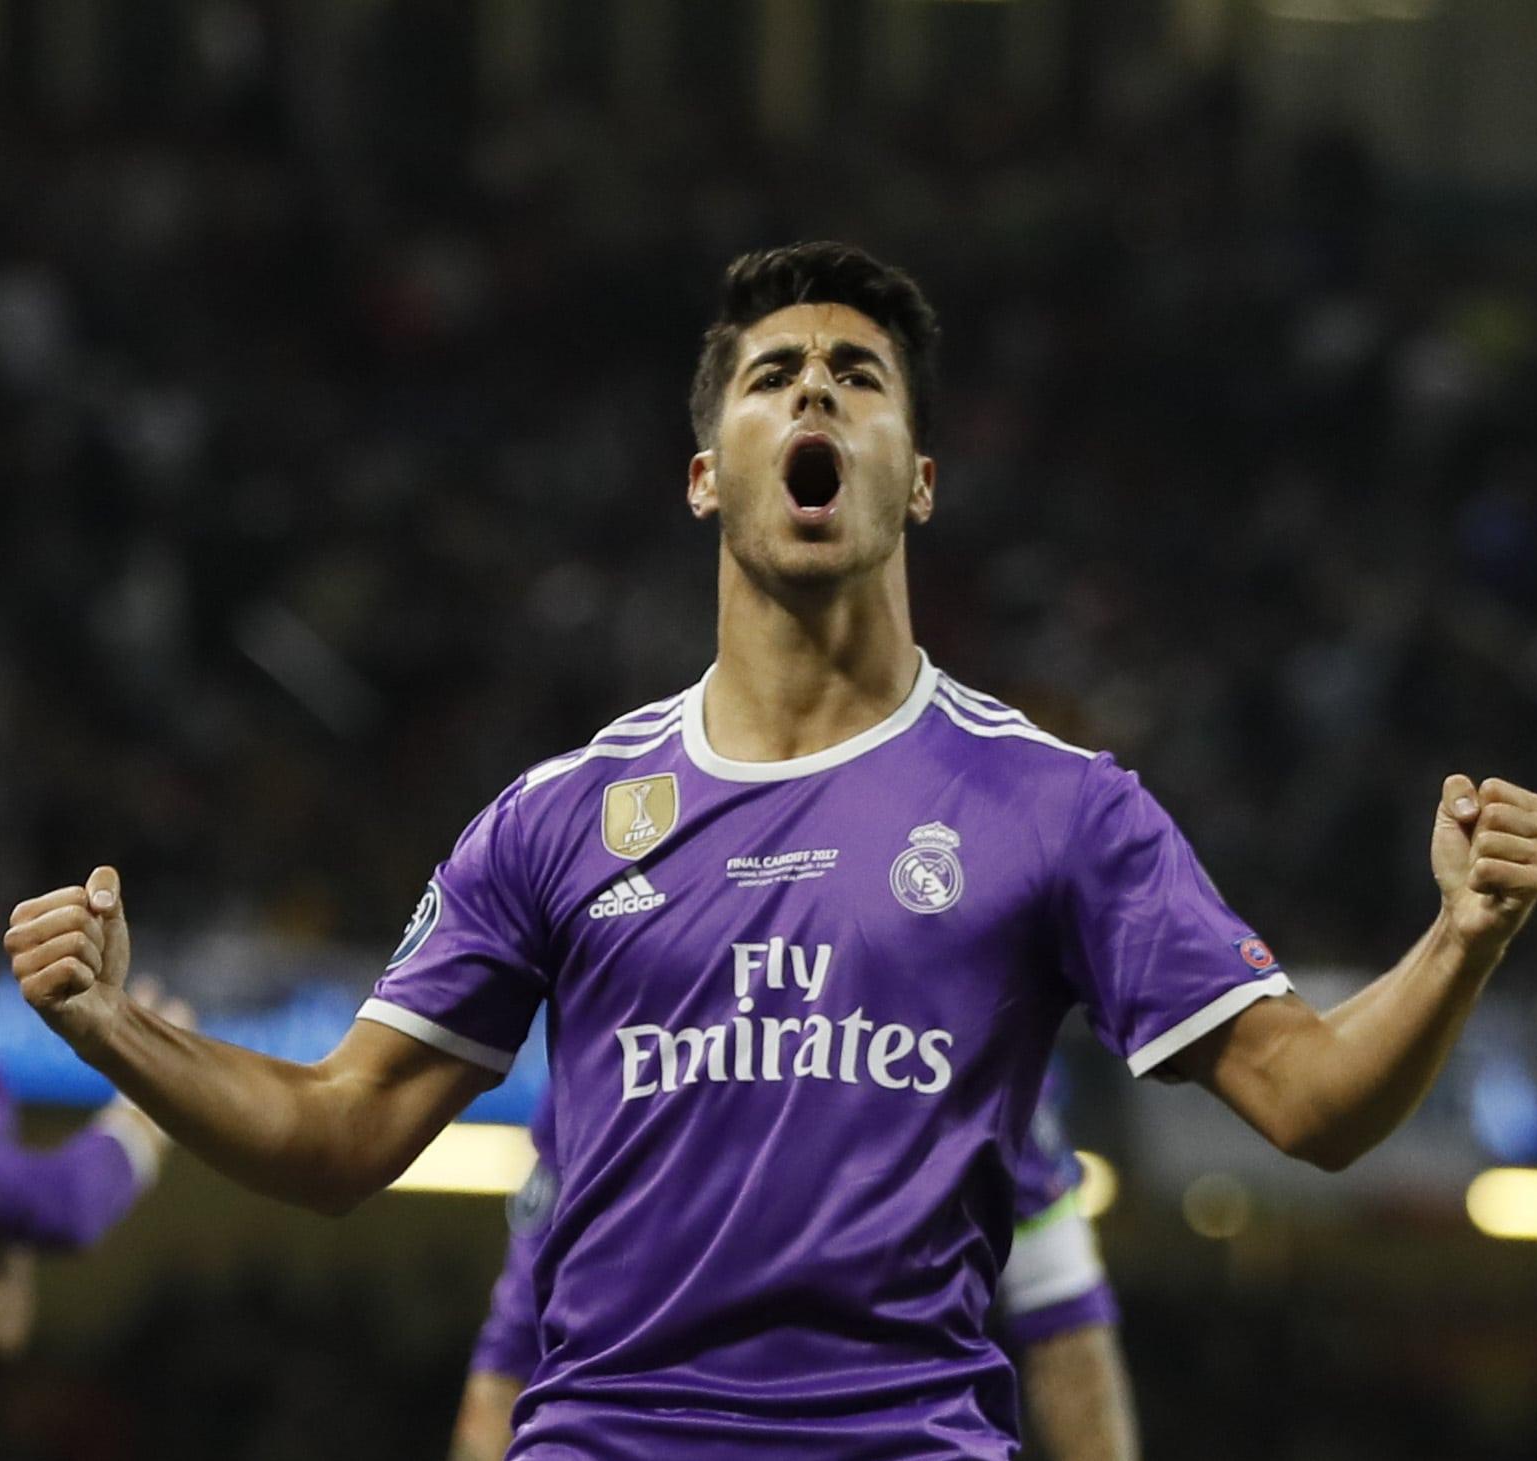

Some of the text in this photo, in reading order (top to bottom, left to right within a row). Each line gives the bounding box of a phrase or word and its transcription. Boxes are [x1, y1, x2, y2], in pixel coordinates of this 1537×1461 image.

[623, 825, 656, 844] FIFA
[726, 857, 762, 871] FINAL
[762, 850, 811, 869] CARDIFF
[812, 848, 839, 861] 2017
[589, 893, 666, 919] adidas
[731, 936, 832, 1002] Fly
[615, 996, 954, 1102] Emirates
